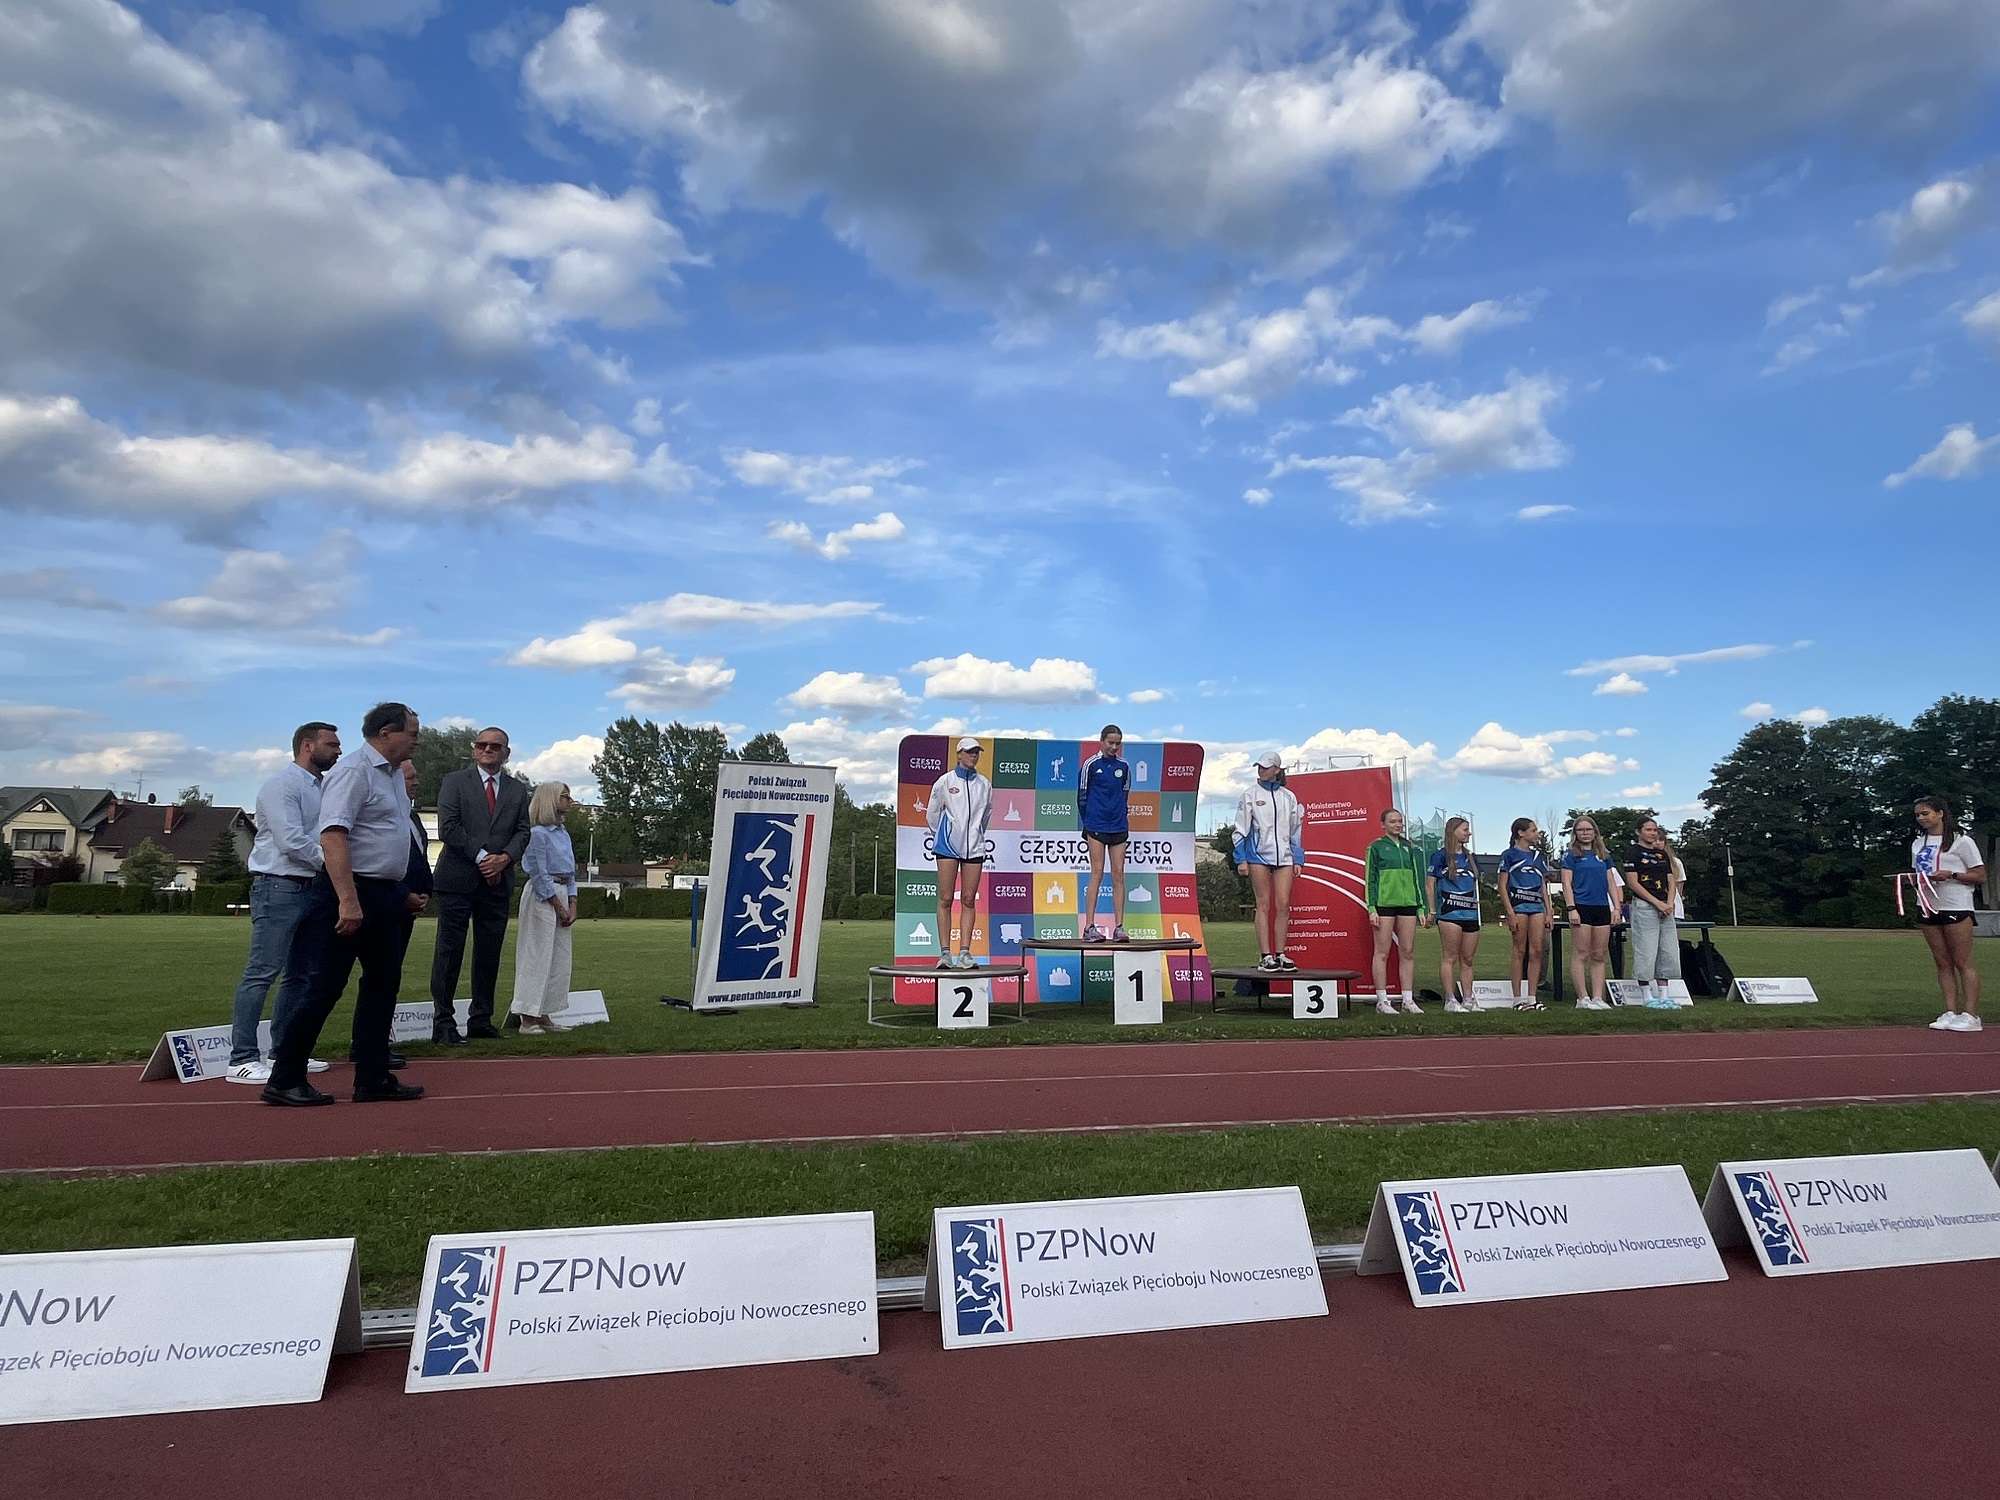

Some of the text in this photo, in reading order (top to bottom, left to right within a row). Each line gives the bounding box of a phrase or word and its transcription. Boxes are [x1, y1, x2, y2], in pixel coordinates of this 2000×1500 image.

[748, 775, 774, 786] Polski
[1307, 811, 1330, 819] Sportu
[1128, 970, 1143, 1001] 1
[1306, 984, 1325, 1014] 3
[952, 986, 974, 1017] 2
[1784, 1178, 1888, 1207] PZPNow
[1451, 1200, 1568, 1231] PZPNow
[1803, 1221, 1836, 1237] Polski
[1836, 1219, 1879, 1236] Związek
[1880, 1214, 1934, 1233] Pięcioboju
[1016, 1226, 1156, 1262] PZPNow
[1464, 1233, 1707, 1264] Polski Związek Pięcioboju Nowoczesnego
[513, 1255, 686, 1296] PZPNow
[1020, 1264, 1314, 1299] Polski Związek Pięcioboju Nowoczesnego
[508, 1298, 868, 1337] Polski Związek Pięcioboju Nowoczesnego
[49, 1344, 160, 1374] Pięcioboju
[166, 1335, 322, 1364] Nowoczesnego
